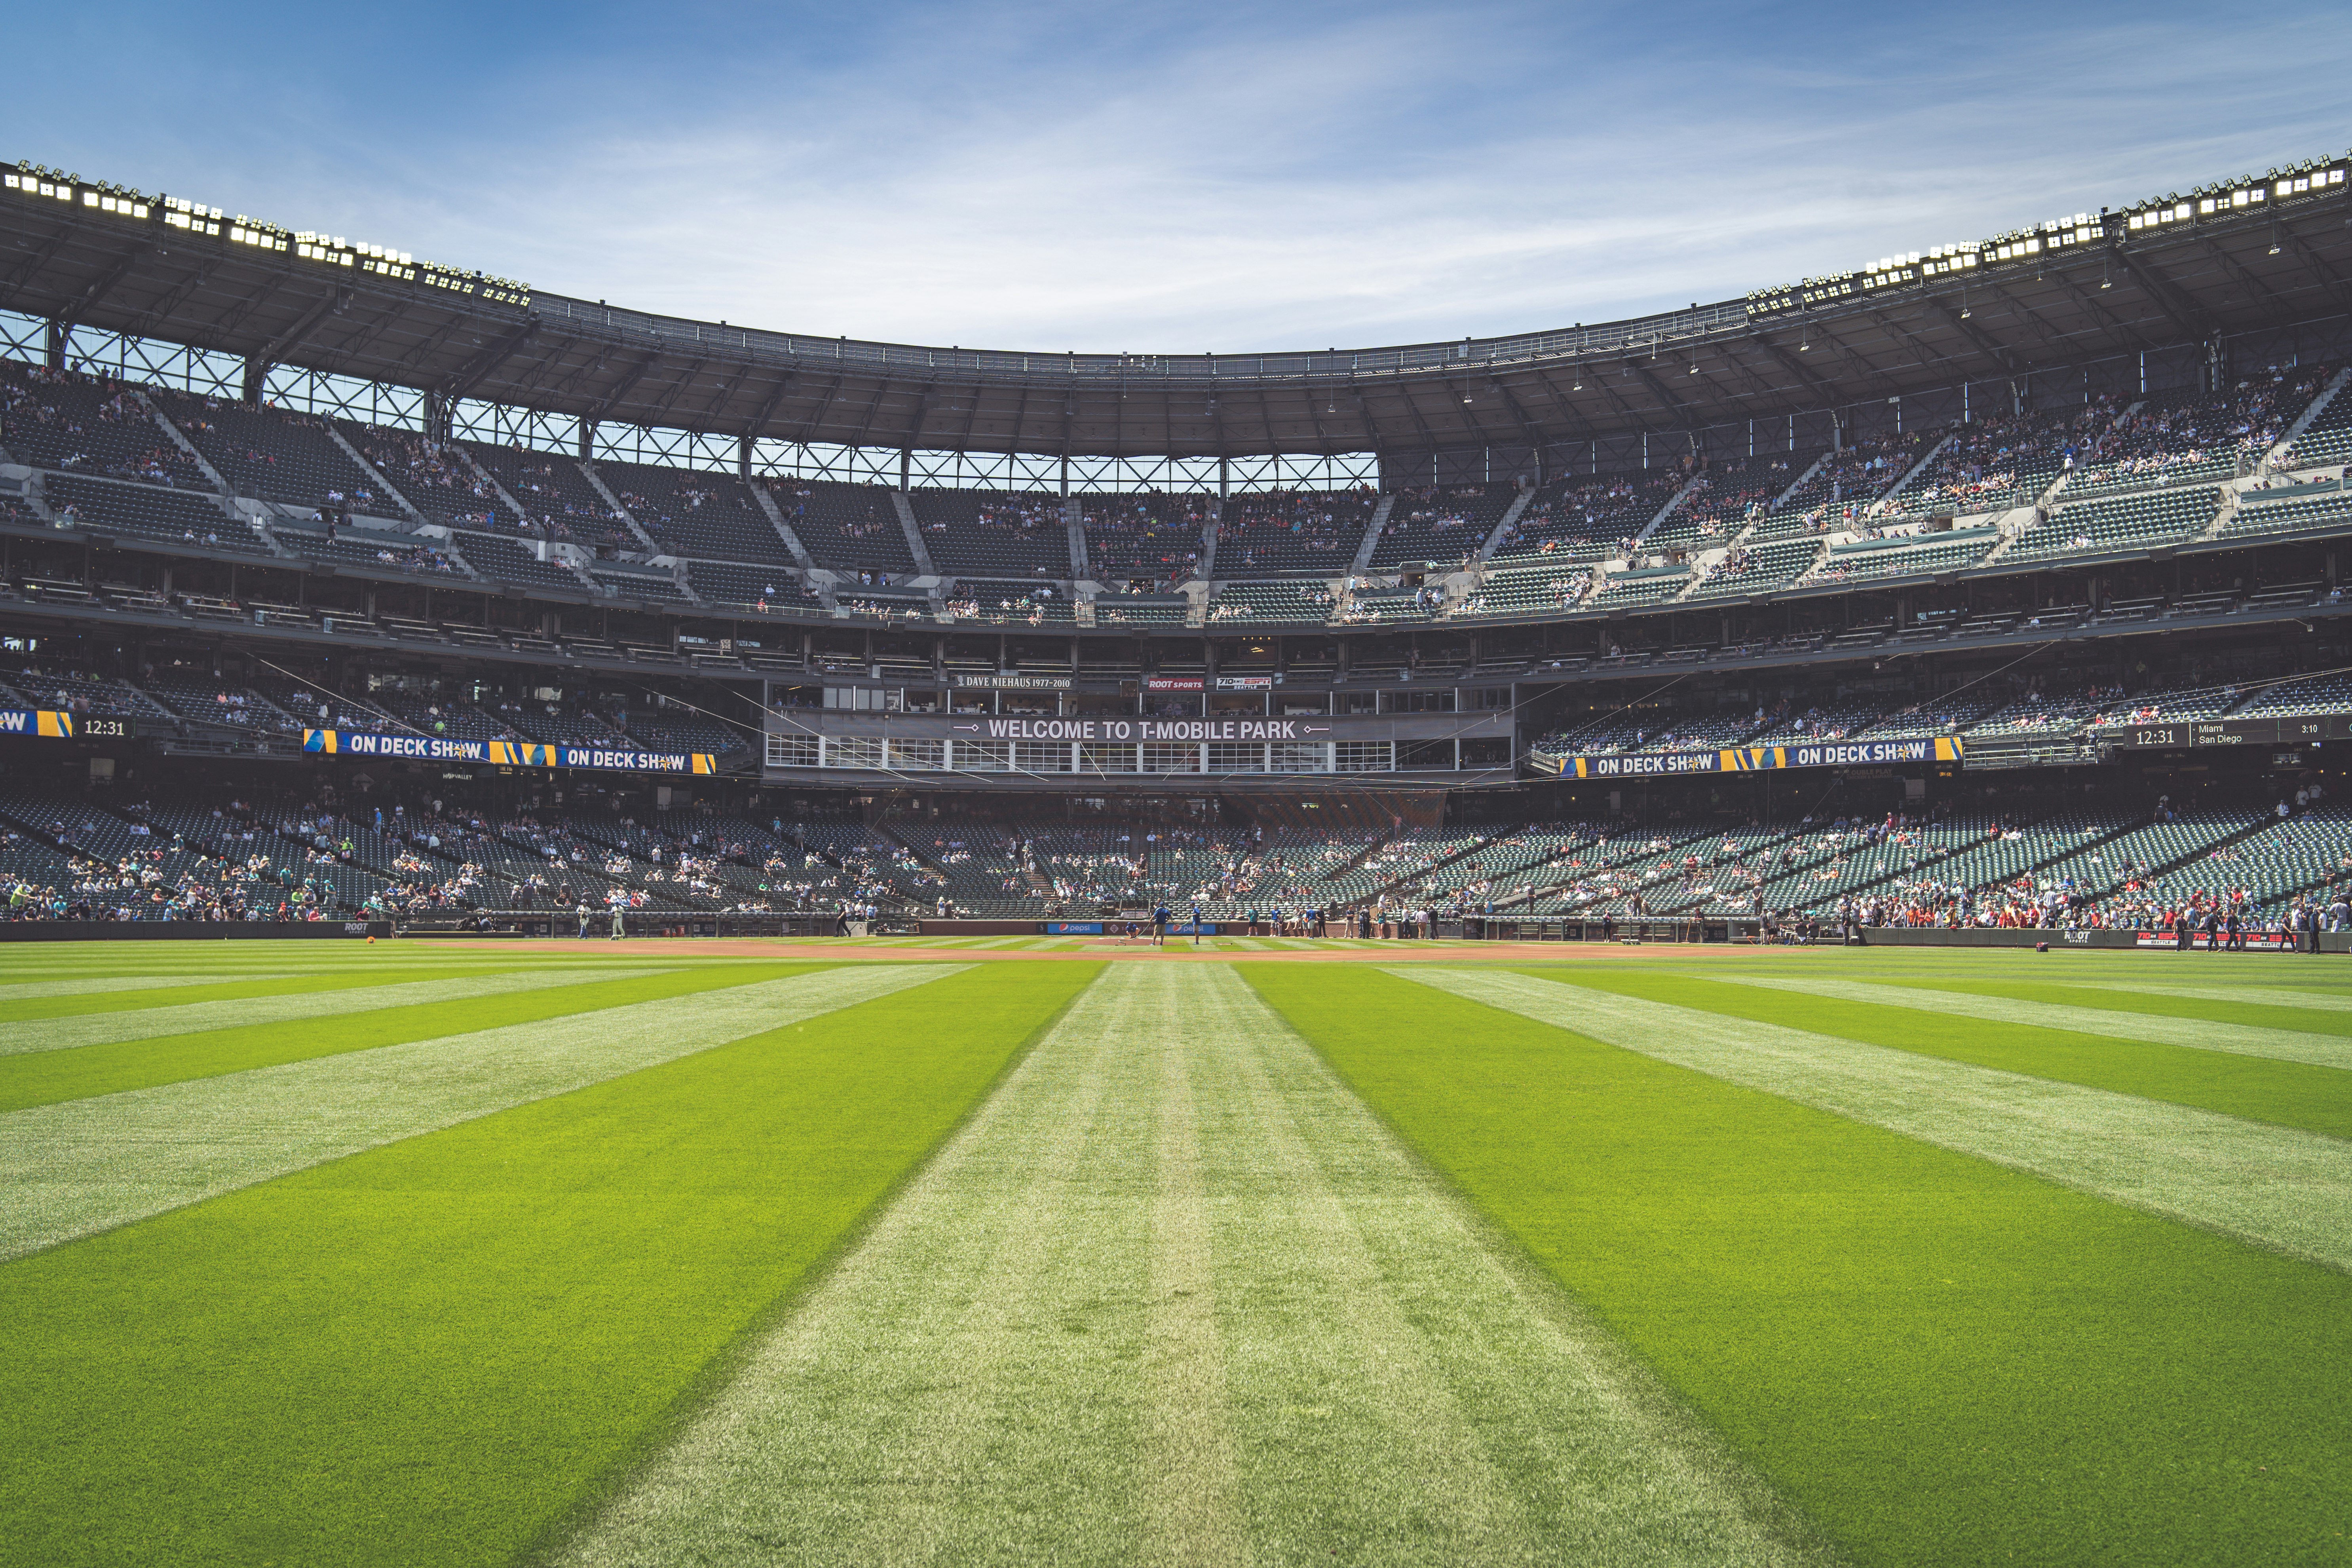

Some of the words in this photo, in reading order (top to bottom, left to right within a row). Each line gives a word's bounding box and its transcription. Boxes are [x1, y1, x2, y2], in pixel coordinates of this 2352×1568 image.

[967, 677, 989, 686] DAVE
[992, 677, 1030, 687] NIEHAUS
[85, 720, 124, 736] 12:31
[988, 719, 1094, 739] WELCOME
[1102, 721, 1130, 739] TO
[1138, 721, 1235, 739] T-MOBILE
[1241, 721, 1296, 739] PARK
[2199, 724, 2223, 733] Miami
[2302, 724, 2317, 733] 3:10
[2137, 730, 2174, 745] 12:31
[2217, 735, 2242, 744] Diego
[351, 735, 376, 753] ON
[380, 737, 427, 756] DECK
[568, 750, 590, 766] ON
[593, 751, 635, 768] DECK
[1798, 748, 1821, 764] ON
[1826, 745, 1870, 763] DECK
[1598, 759, 1619, 774] ON
[1623, 756, 1664, 773] DECK
[2064, 931, 2090, 939] ROOT
